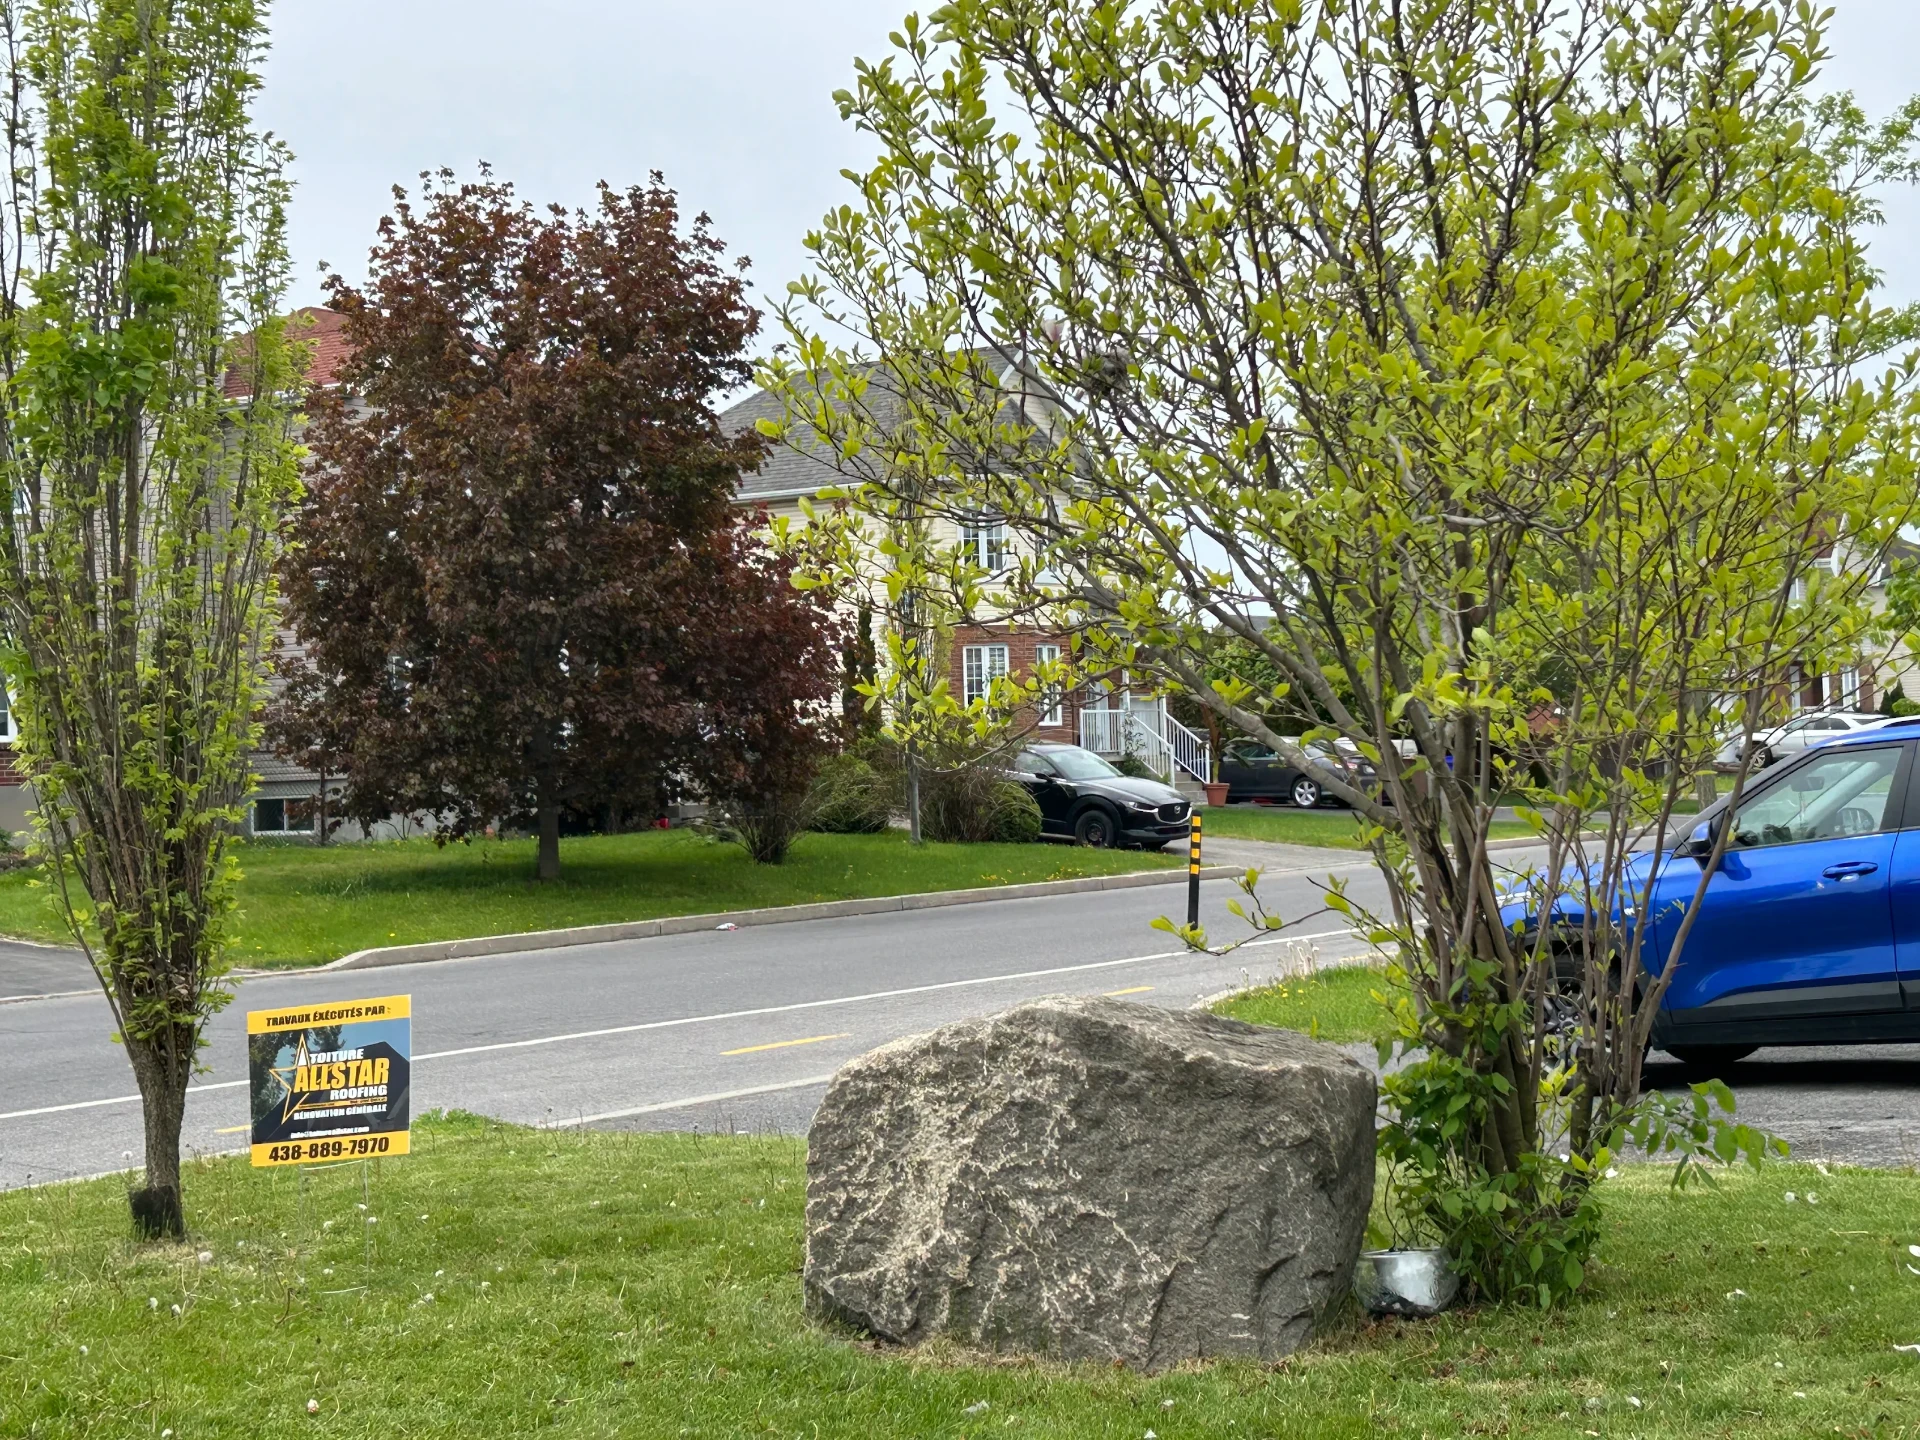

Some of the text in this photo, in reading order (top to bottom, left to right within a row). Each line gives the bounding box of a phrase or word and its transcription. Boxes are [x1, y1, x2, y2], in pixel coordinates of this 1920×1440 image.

[266, 1013, 311, 1027] TRAVAUX
[364, 1005, 386, 1016] PAR
[309, 1048, 364, 1064] TOITURE
[294, 1057, 390, 1093] ALLSTAR
[330, 1085, 388, 1101] ROOFING
[268, 1137, 390, 1162] 438-889-7970
